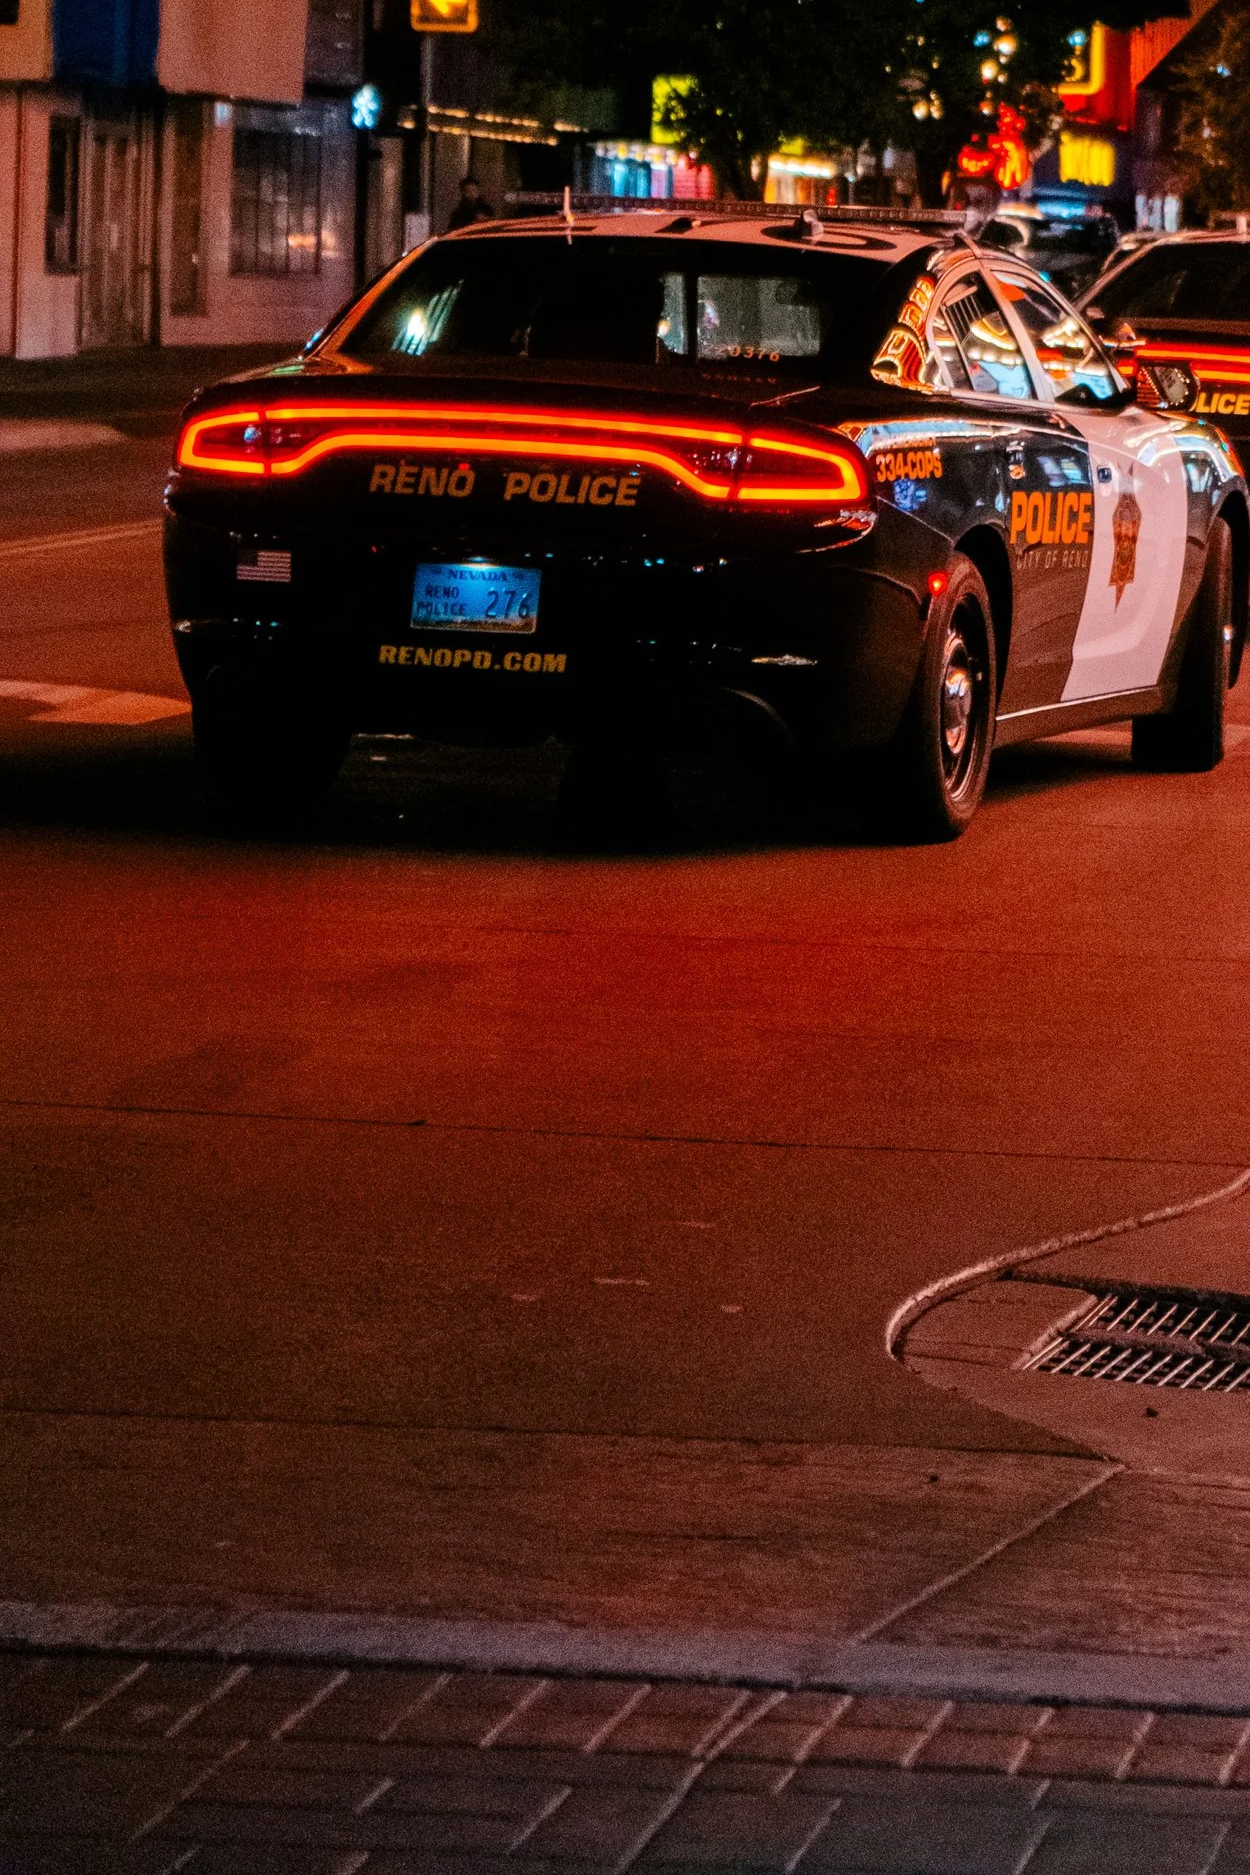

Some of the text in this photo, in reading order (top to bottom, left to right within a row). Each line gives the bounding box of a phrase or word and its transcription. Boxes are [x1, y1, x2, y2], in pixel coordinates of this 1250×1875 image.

[875, 449, 943, 483] 334-COPS
[368, 463, 641, 506] RENO POLICE
[1009, 490, 1093, 545] POLICE
[1015, 549, 1089, 570] CITY OF RENO
[447, 569, 508, 582] NEVADA
[425, 584, 460, 599] RENO
[484, 589, 533, 619] 276
[416, 601, 467, 616] POLICE
[378, 644, 567, 673] RENOPD.COM
